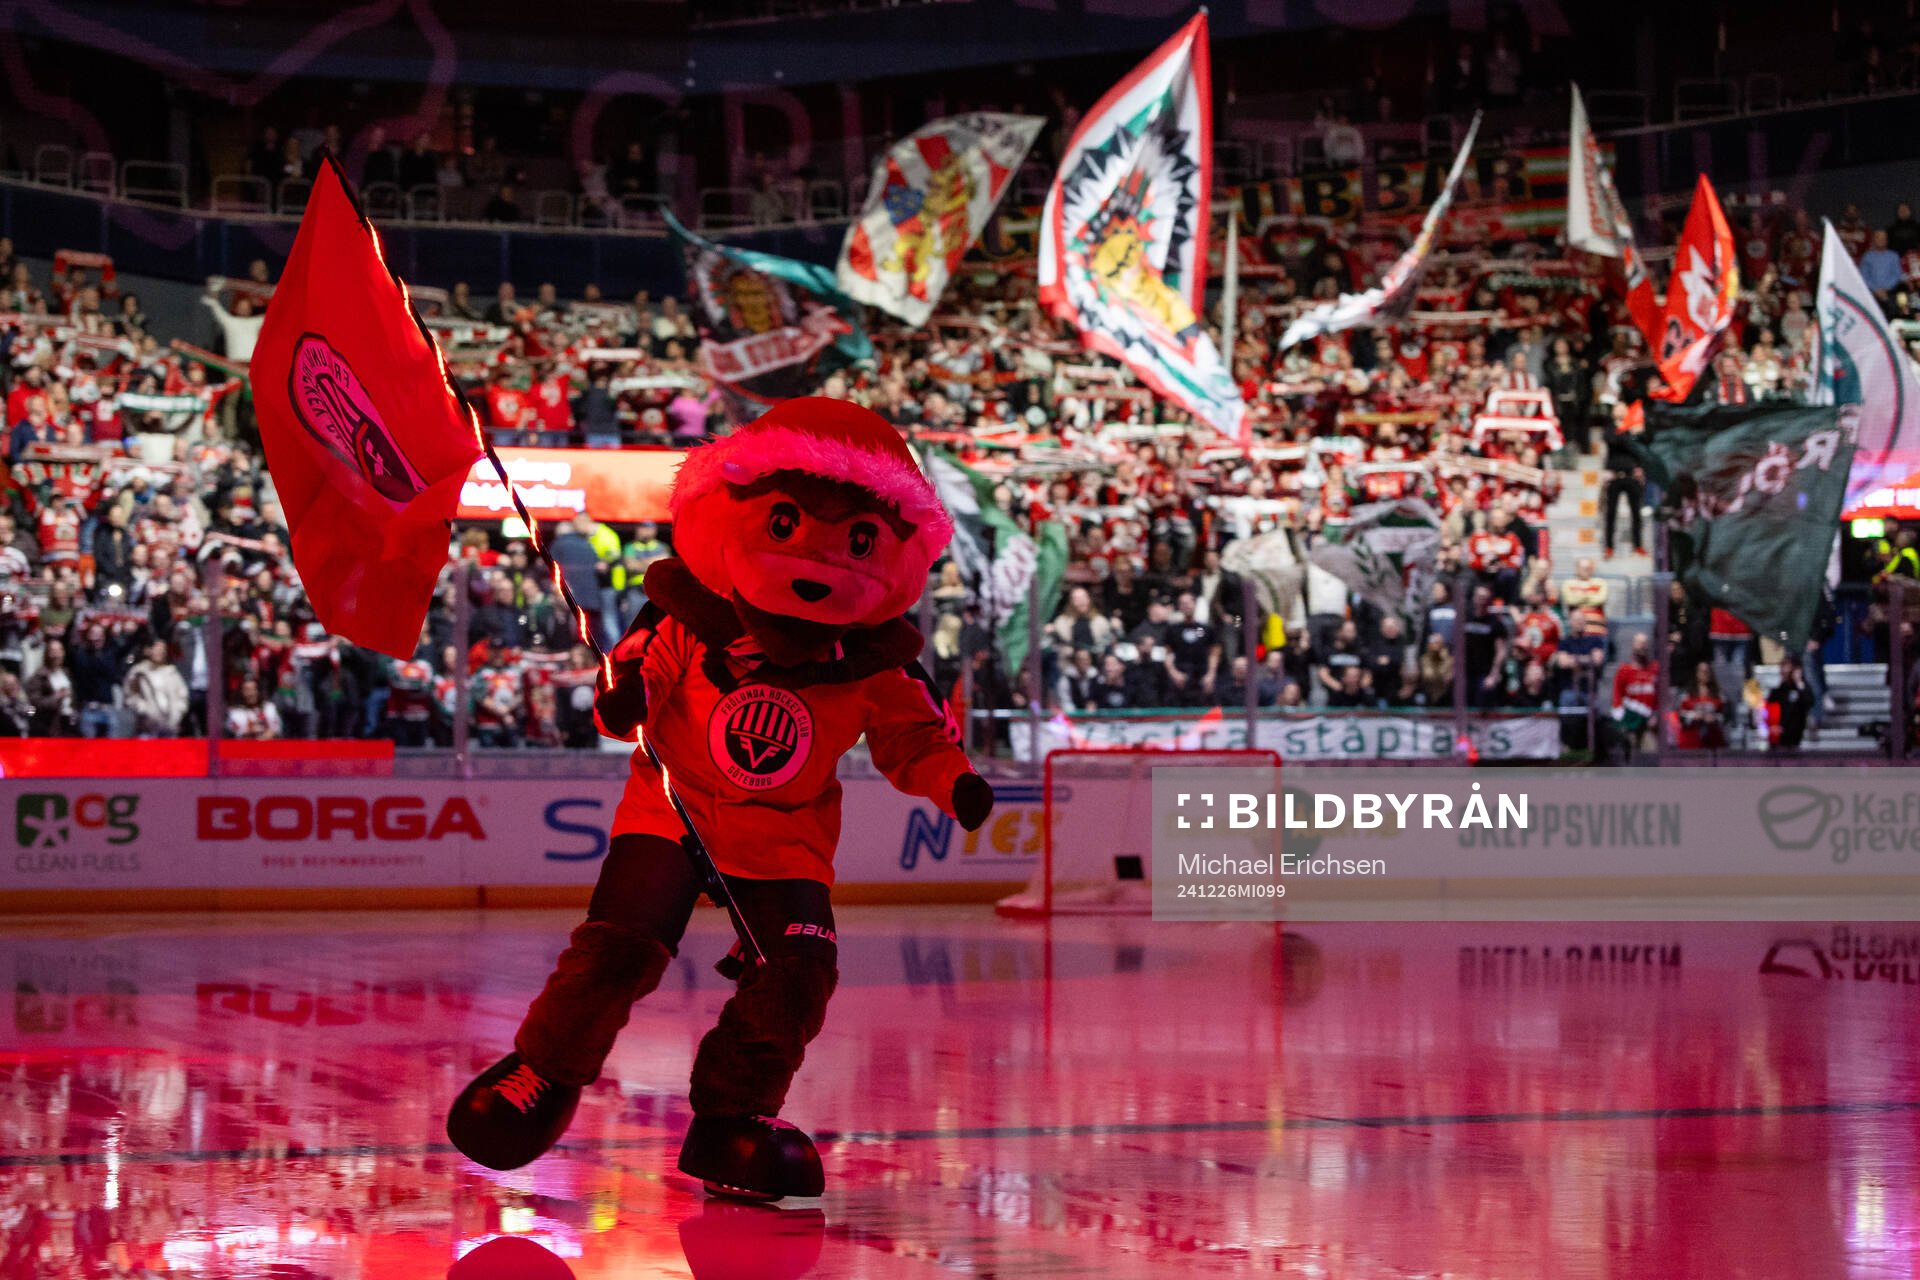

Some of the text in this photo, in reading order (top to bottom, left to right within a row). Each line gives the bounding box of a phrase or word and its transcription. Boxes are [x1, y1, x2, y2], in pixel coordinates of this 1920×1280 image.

[721, 688, 809, 738] FRÖLUNDA HOCKEY CLUB
[727, 765, 772, 787] GÖTEBORG
[196, 796, 487, 841] BORGA
[1853, 791, 1920, 823] Kaf
[14, 853, 141, 873] CLEAN FUELS
